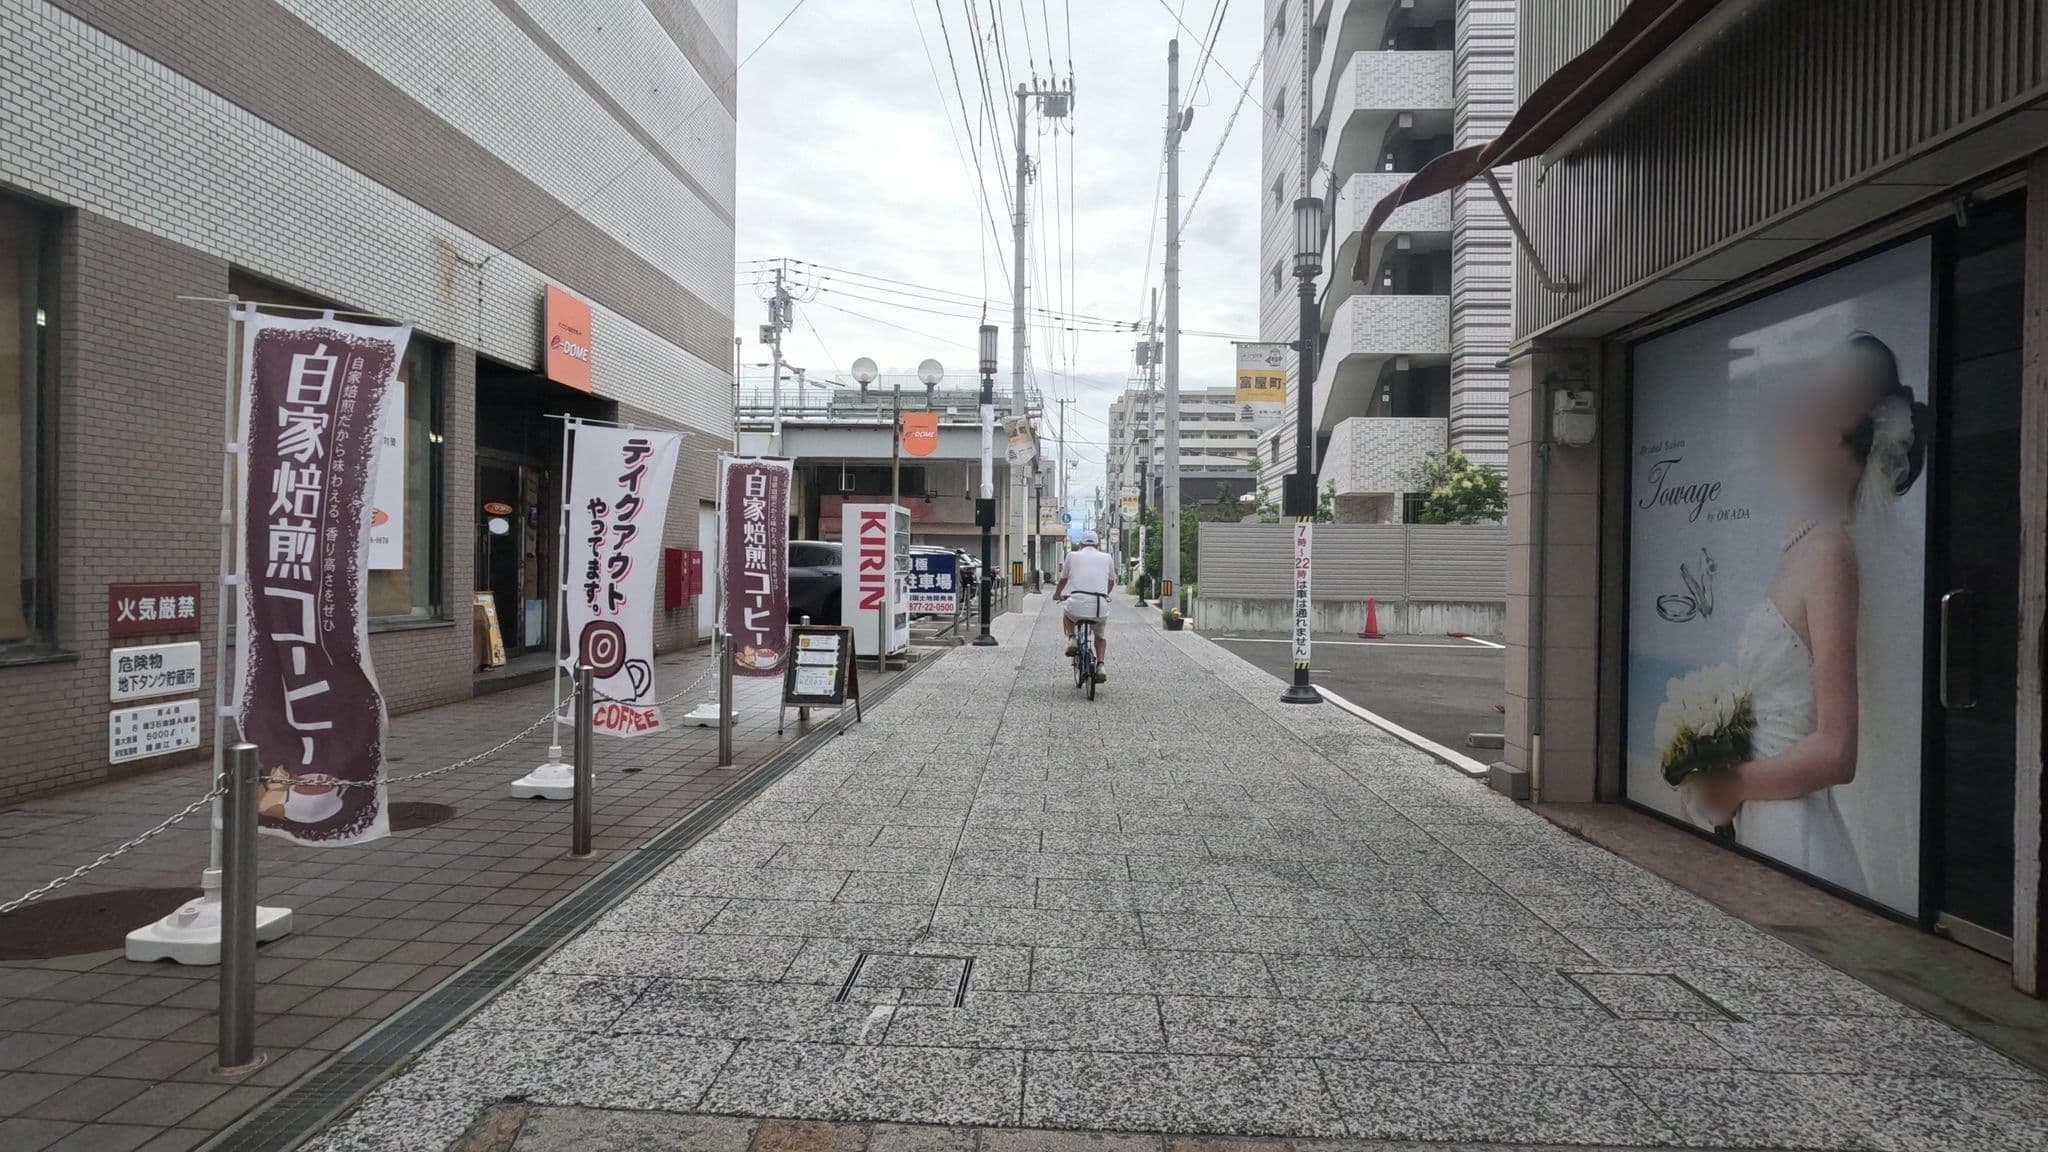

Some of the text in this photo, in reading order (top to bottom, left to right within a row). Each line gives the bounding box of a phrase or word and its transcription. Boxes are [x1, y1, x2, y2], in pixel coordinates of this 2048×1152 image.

[1240, 376, 1282, 389] 富屋町
[322, 356, 364, 632] 自家焙煎だから味わえる、香り高さをぜひ
[1639, 456, 1721, 523] Towage
[1717, 508, 1750, 521] OKADA
[263, 342, 338, 765] 自家焙煎コーヒー
[584, 497, 608, 614] やってます。
[607, 439, 653, 613] テイクアウト
[743, 469, 771, 645] 自家焙煎コーヒー
[860, 511, 886, 610] KIRIN
[117, 596, 195, 622] 火気厳禁
[118, 653, 163, 674] 危険物
[118, 668, 195, 692] 地下タンク貯蔵所
[593, 704, 659, 733] COFFEE
